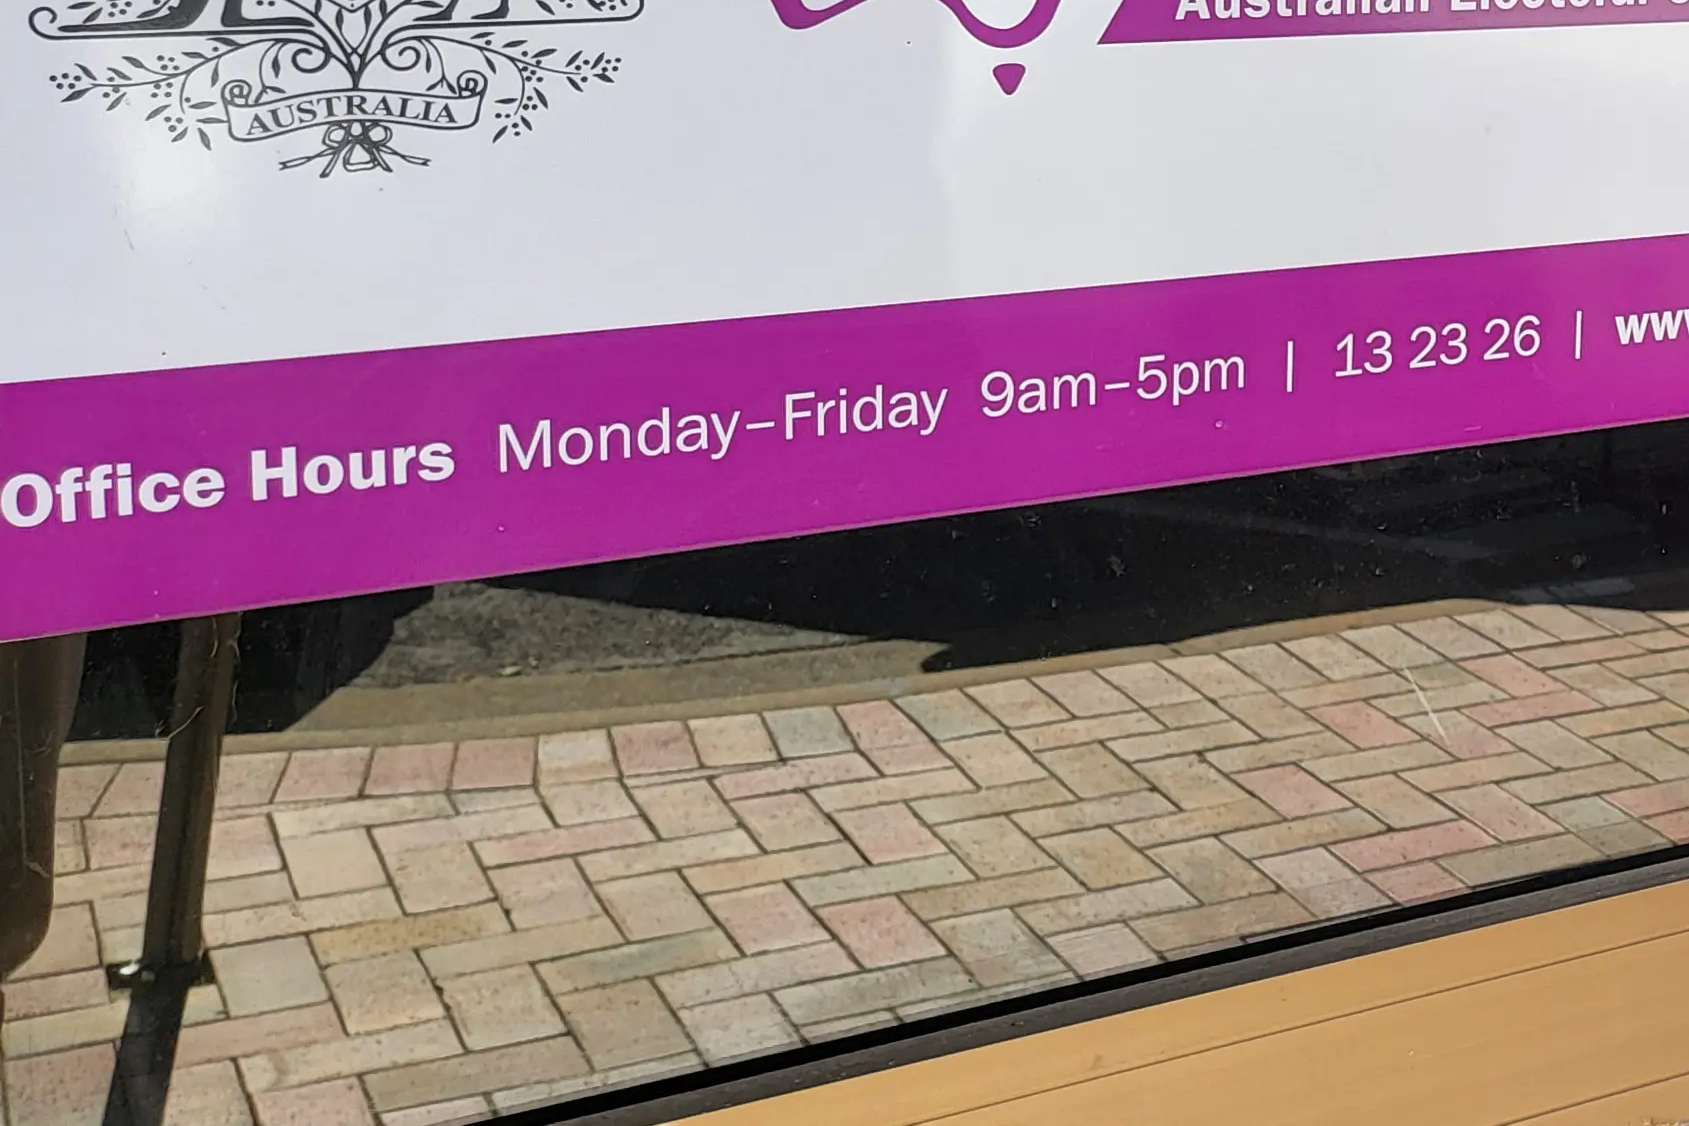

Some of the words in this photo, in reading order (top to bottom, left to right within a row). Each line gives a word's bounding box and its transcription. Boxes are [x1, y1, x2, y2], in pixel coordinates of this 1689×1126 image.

[246, 94, 458, 136] AUSTRALIA
[0, 464, 225, 528] Office
[252, 443, 455, 501] Hours
[1336, 331, 1392, 377] 13
[1410, 323, 1468, 369] 23
[1484, 316, 1541, 360] 26
